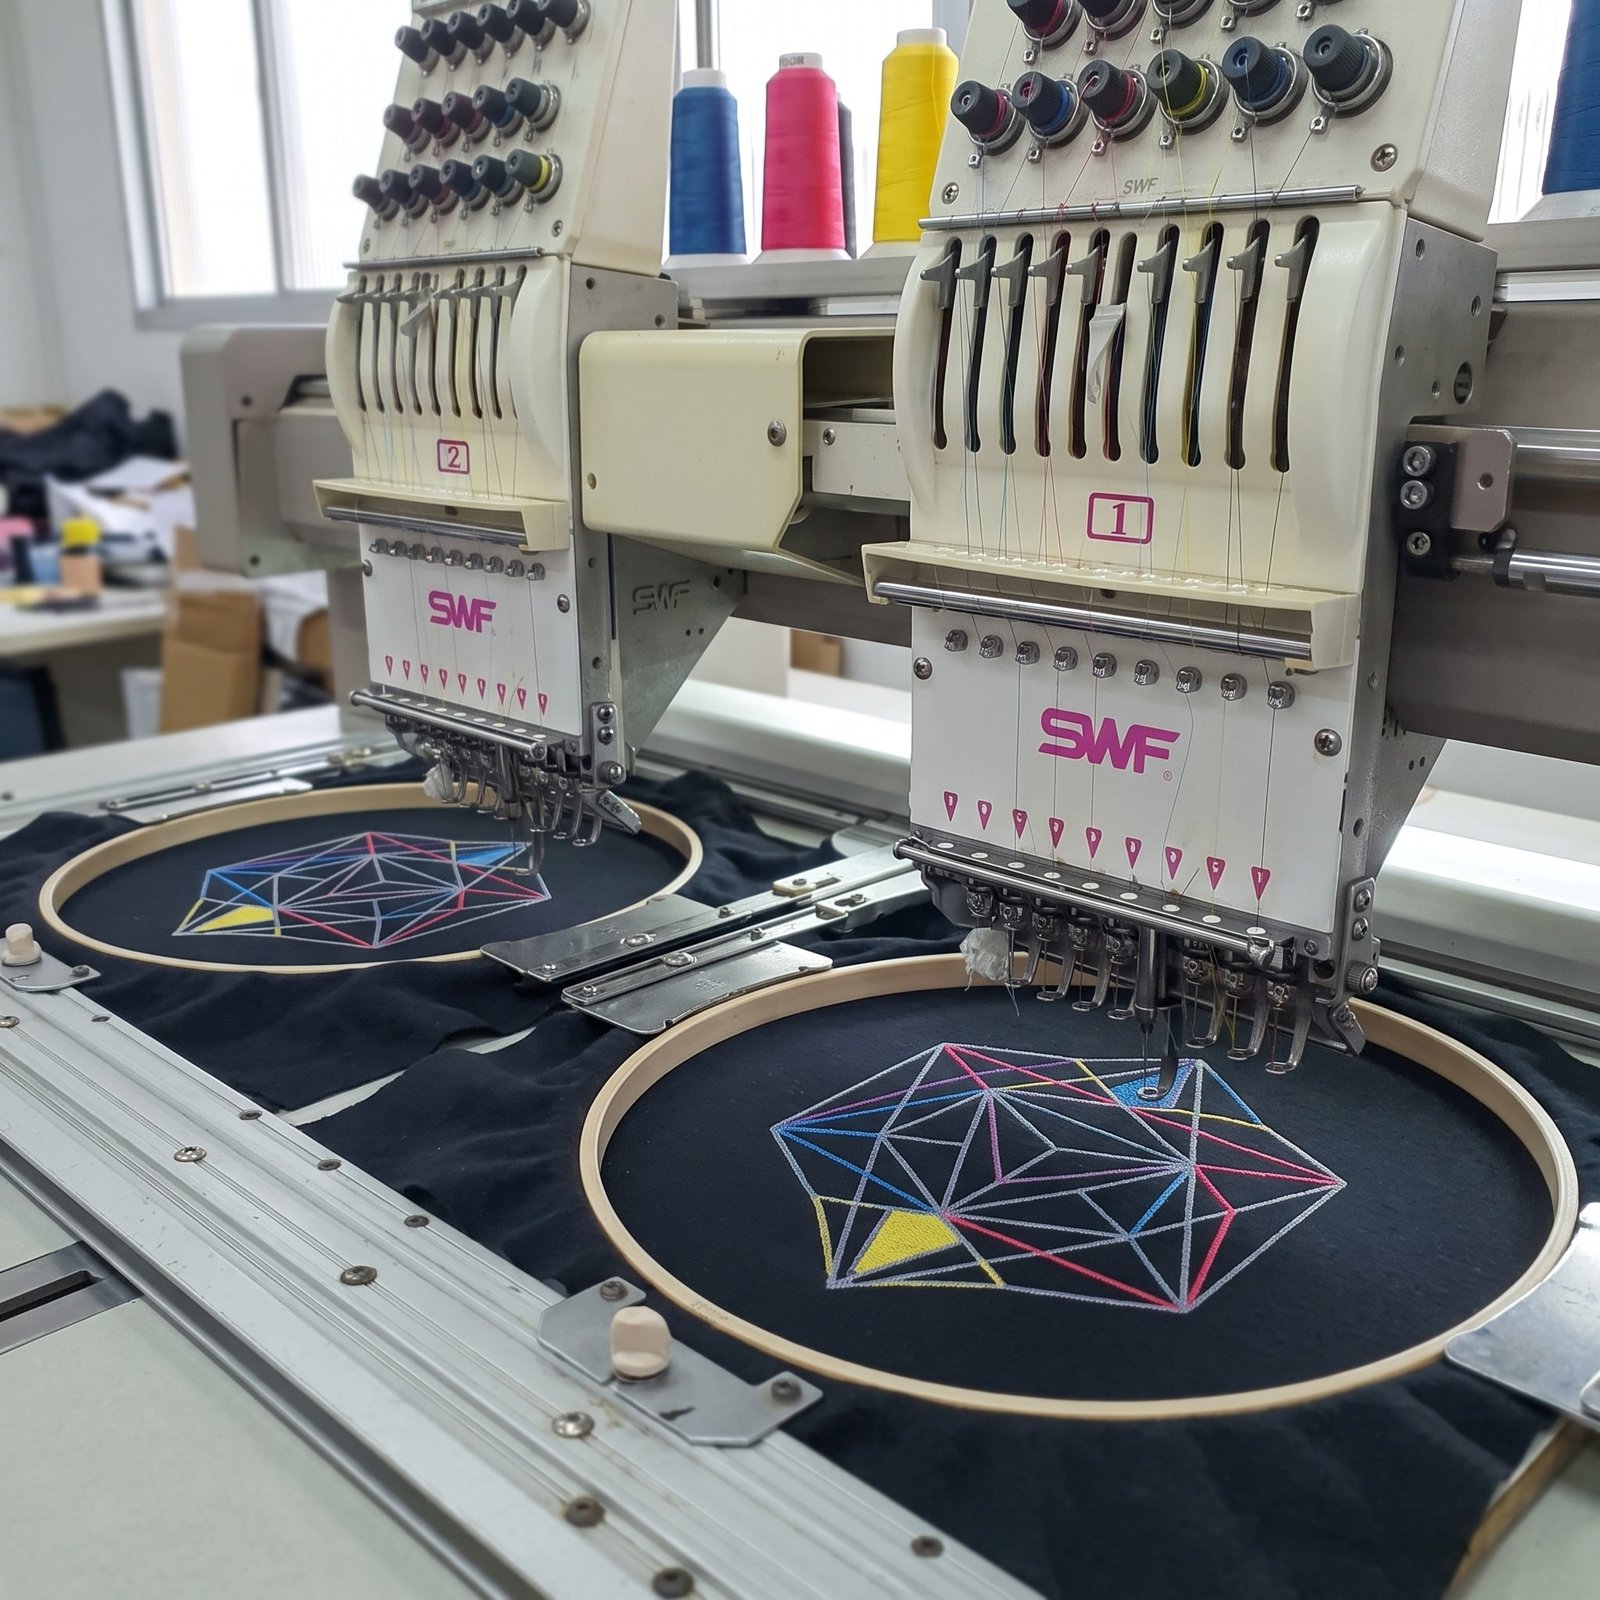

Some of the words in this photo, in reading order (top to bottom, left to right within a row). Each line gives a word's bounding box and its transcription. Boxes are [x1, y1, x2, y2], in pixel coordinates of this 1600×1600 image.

[1122, 177, 1159, 195] SWF
[448, 446, 461, 469] 2
[1111, 502, 1126, 535] 1
[428, 590, 497, 633] SWF
[632, 579, 691, 615] SWF
[1038, 707, 1181, 774] SWF
